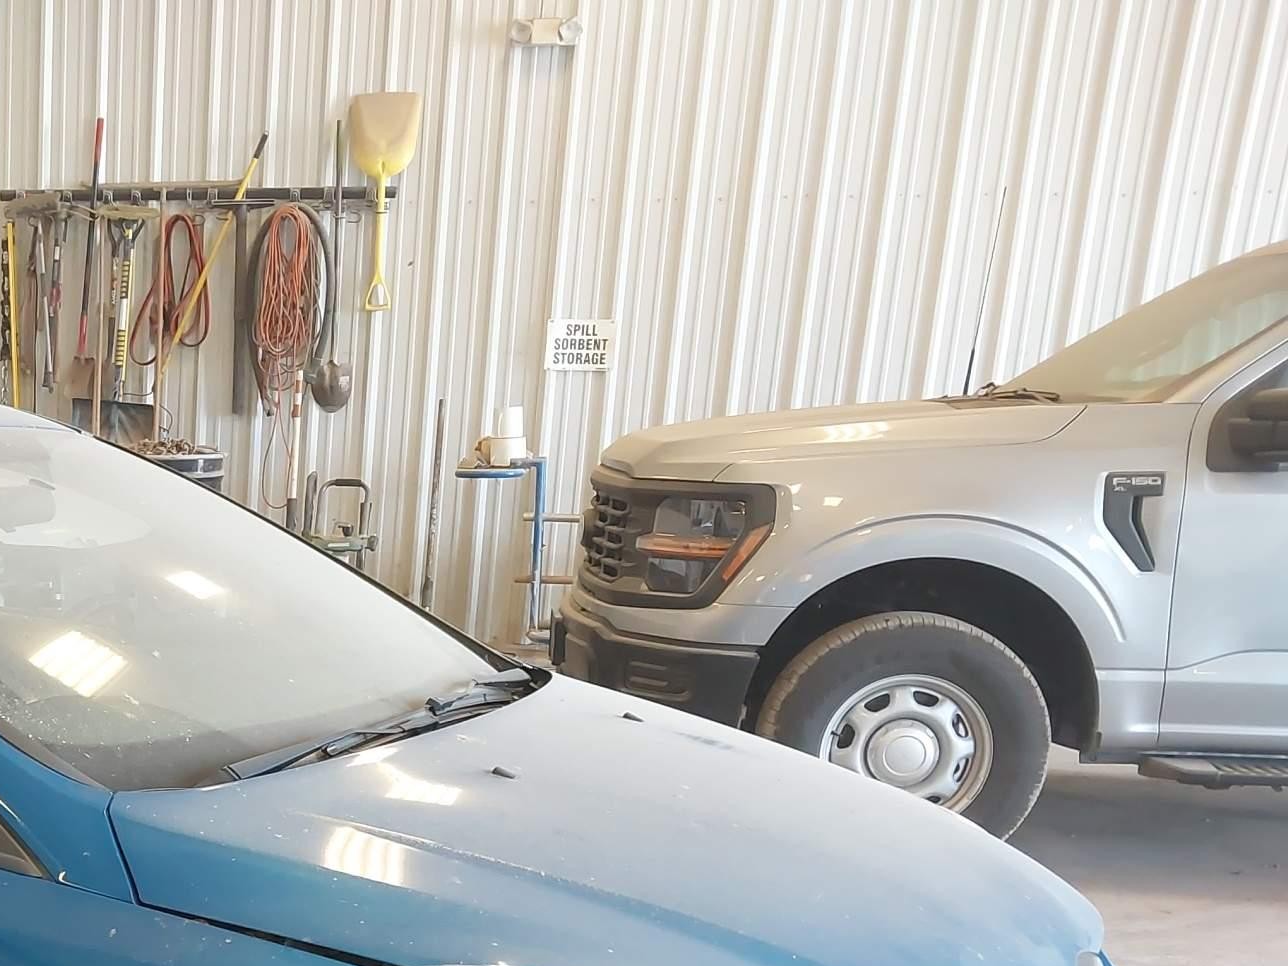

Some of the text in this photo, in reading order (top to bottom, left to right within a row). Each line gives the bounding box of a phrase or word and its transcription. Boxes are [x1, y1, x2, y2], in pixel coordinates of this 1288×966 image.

[566, 324, 598, 336] SPILL
[554, 338, 609, 350] SORBENT
[553, 352, 606, 364] STORAGE
[1113, 476, 1162, 486] F-150
